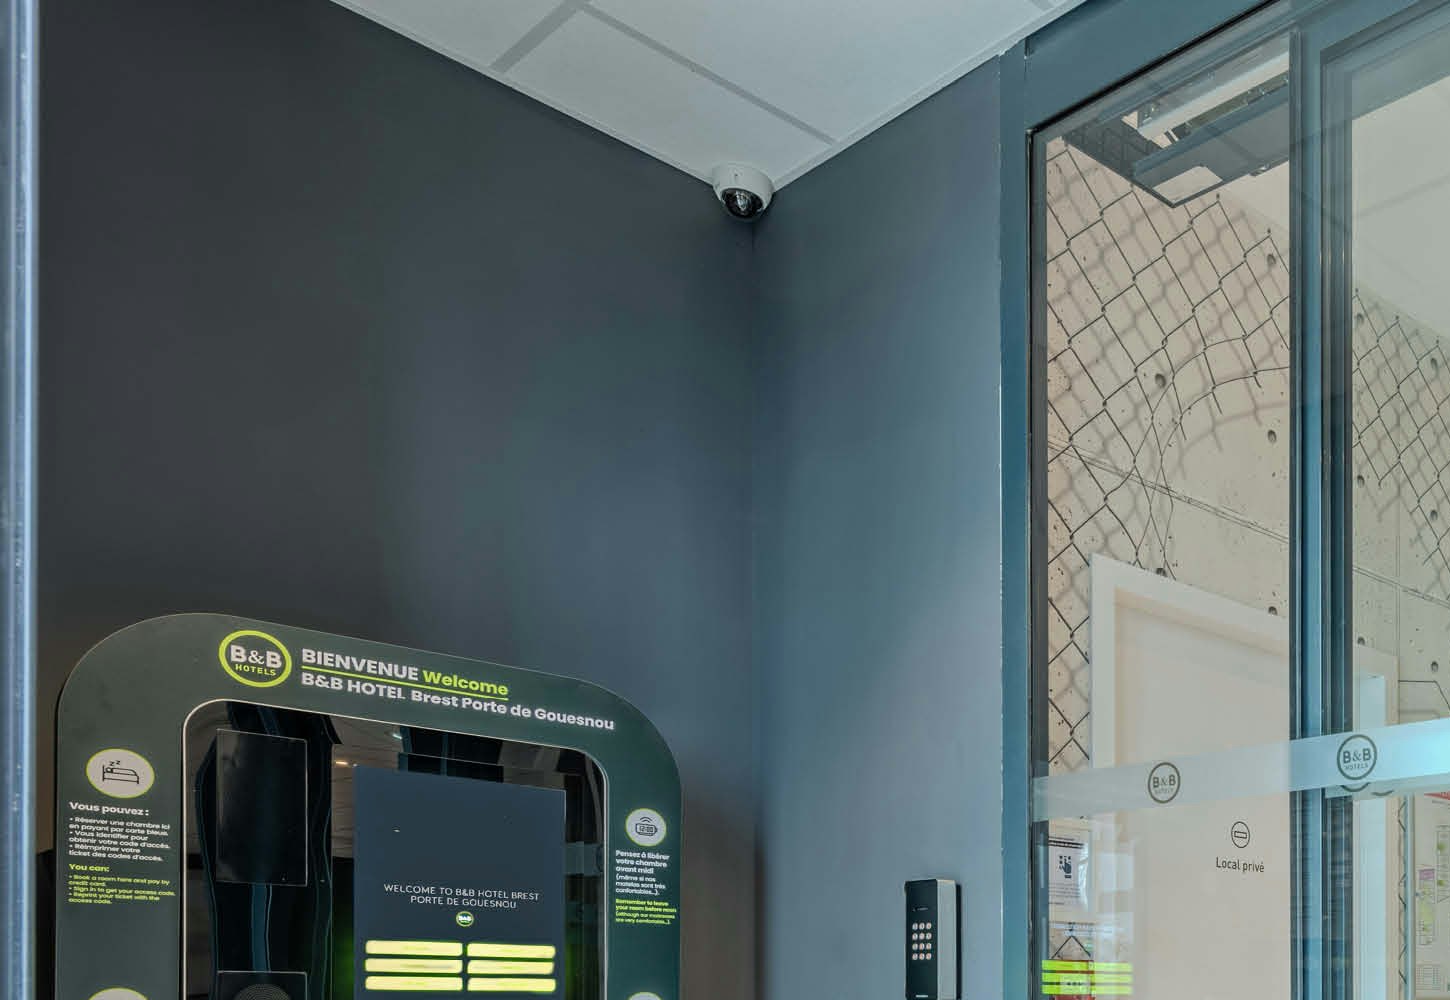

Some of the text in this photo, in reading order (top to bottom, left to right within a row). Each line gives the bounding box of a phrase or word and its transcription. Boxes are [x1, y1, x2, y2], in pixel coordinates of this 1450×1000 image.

[230, 644, 282, 669] B&B
[235, 663, 276, 677] HOTELS
[302, 648, 508, 696] BIENVENUE Welcome
[301, 672, 615, 730] B&B HOTEL Brest Porte de Gouesnou
[1343, 748, 1371, 763] B&B
[1153, 774, 1176, 788] B&B
[69, 802, 100, 812] Vous
[102, 805, 144, 815] pouvez
[69, 863, 87, 871] You
[1216, 856, 1264, 873] Local privé
[384, 884, 540, 901] WELCOME TO B&B HOTEL BREST
[410, 895, 517, 909] PORTE DE GOUESNOU
